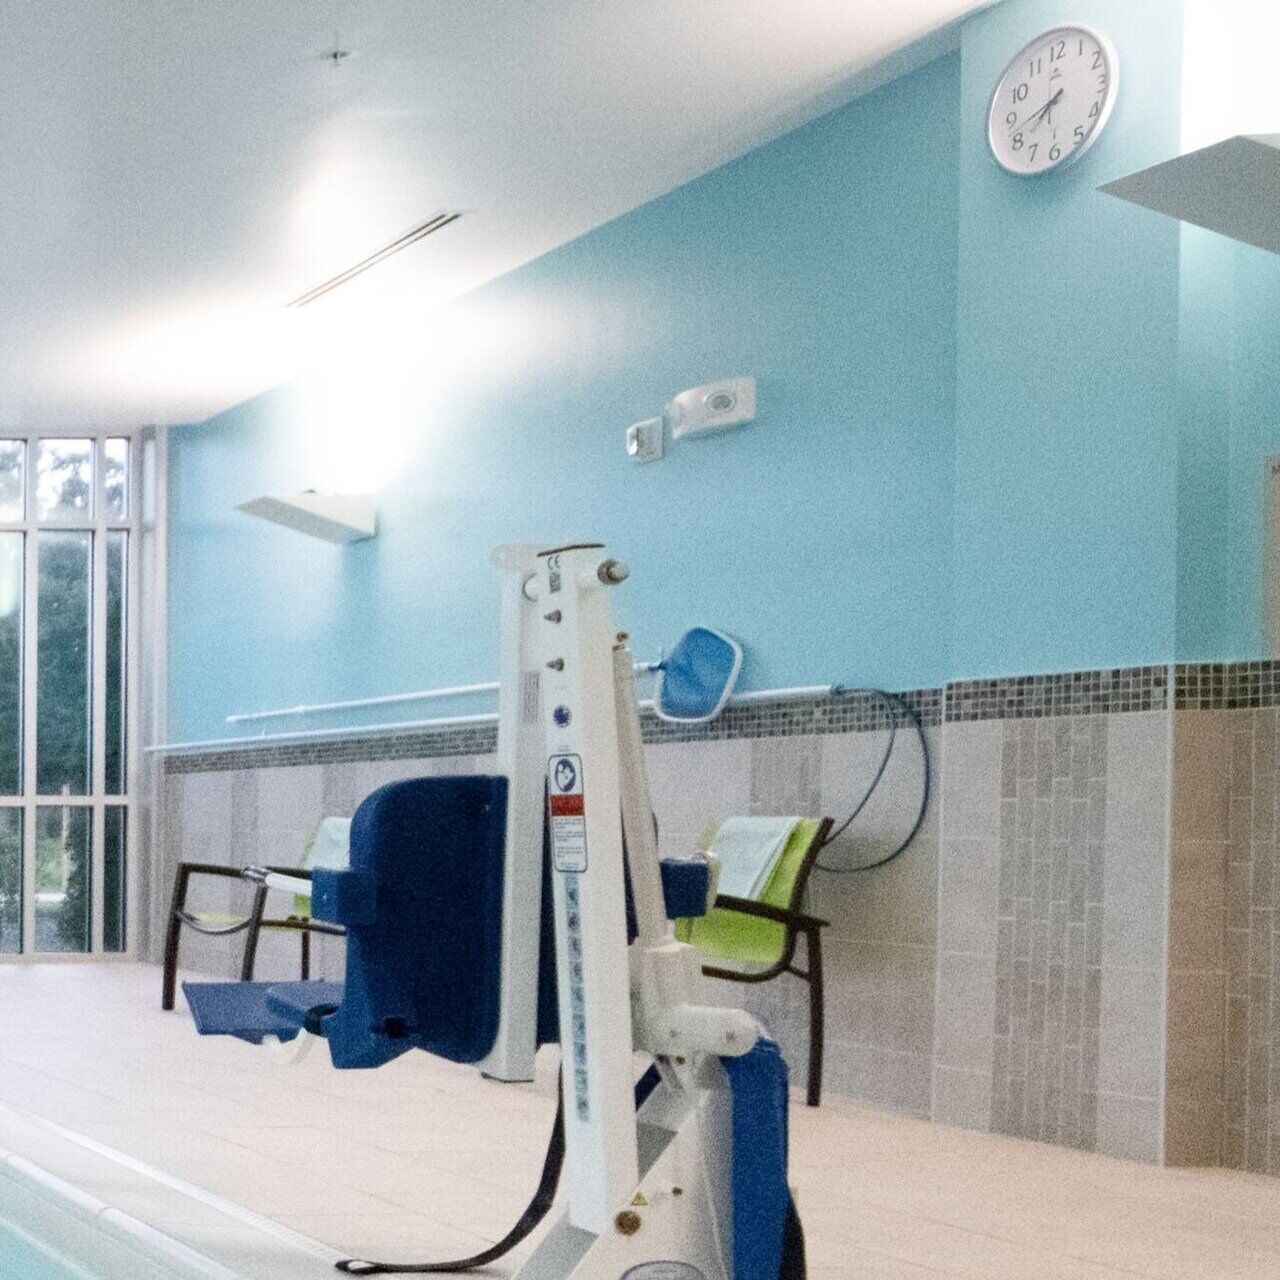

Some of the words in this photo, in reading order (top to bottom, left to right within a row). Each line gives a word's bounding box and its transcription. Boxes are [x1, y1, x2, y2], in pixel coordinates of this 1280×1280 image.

[1050, 41, 1066, 61] 12
[1078, 40, 1084, 56] 1
[1029, 57, 1042, 78] 11
[1091, 50, 1102, 71] 2
[1012, 83, 1028, 104] 10
[1006, 111, 1017, 127] 9
[1088, 101, 1100, 119] 4
[1012, 133, 1024, 151] 8
[1073, 126, 1085, 145] 5
[1028, 145, 1039, 163] 7
[1049, 145, 1061, 162] 6
